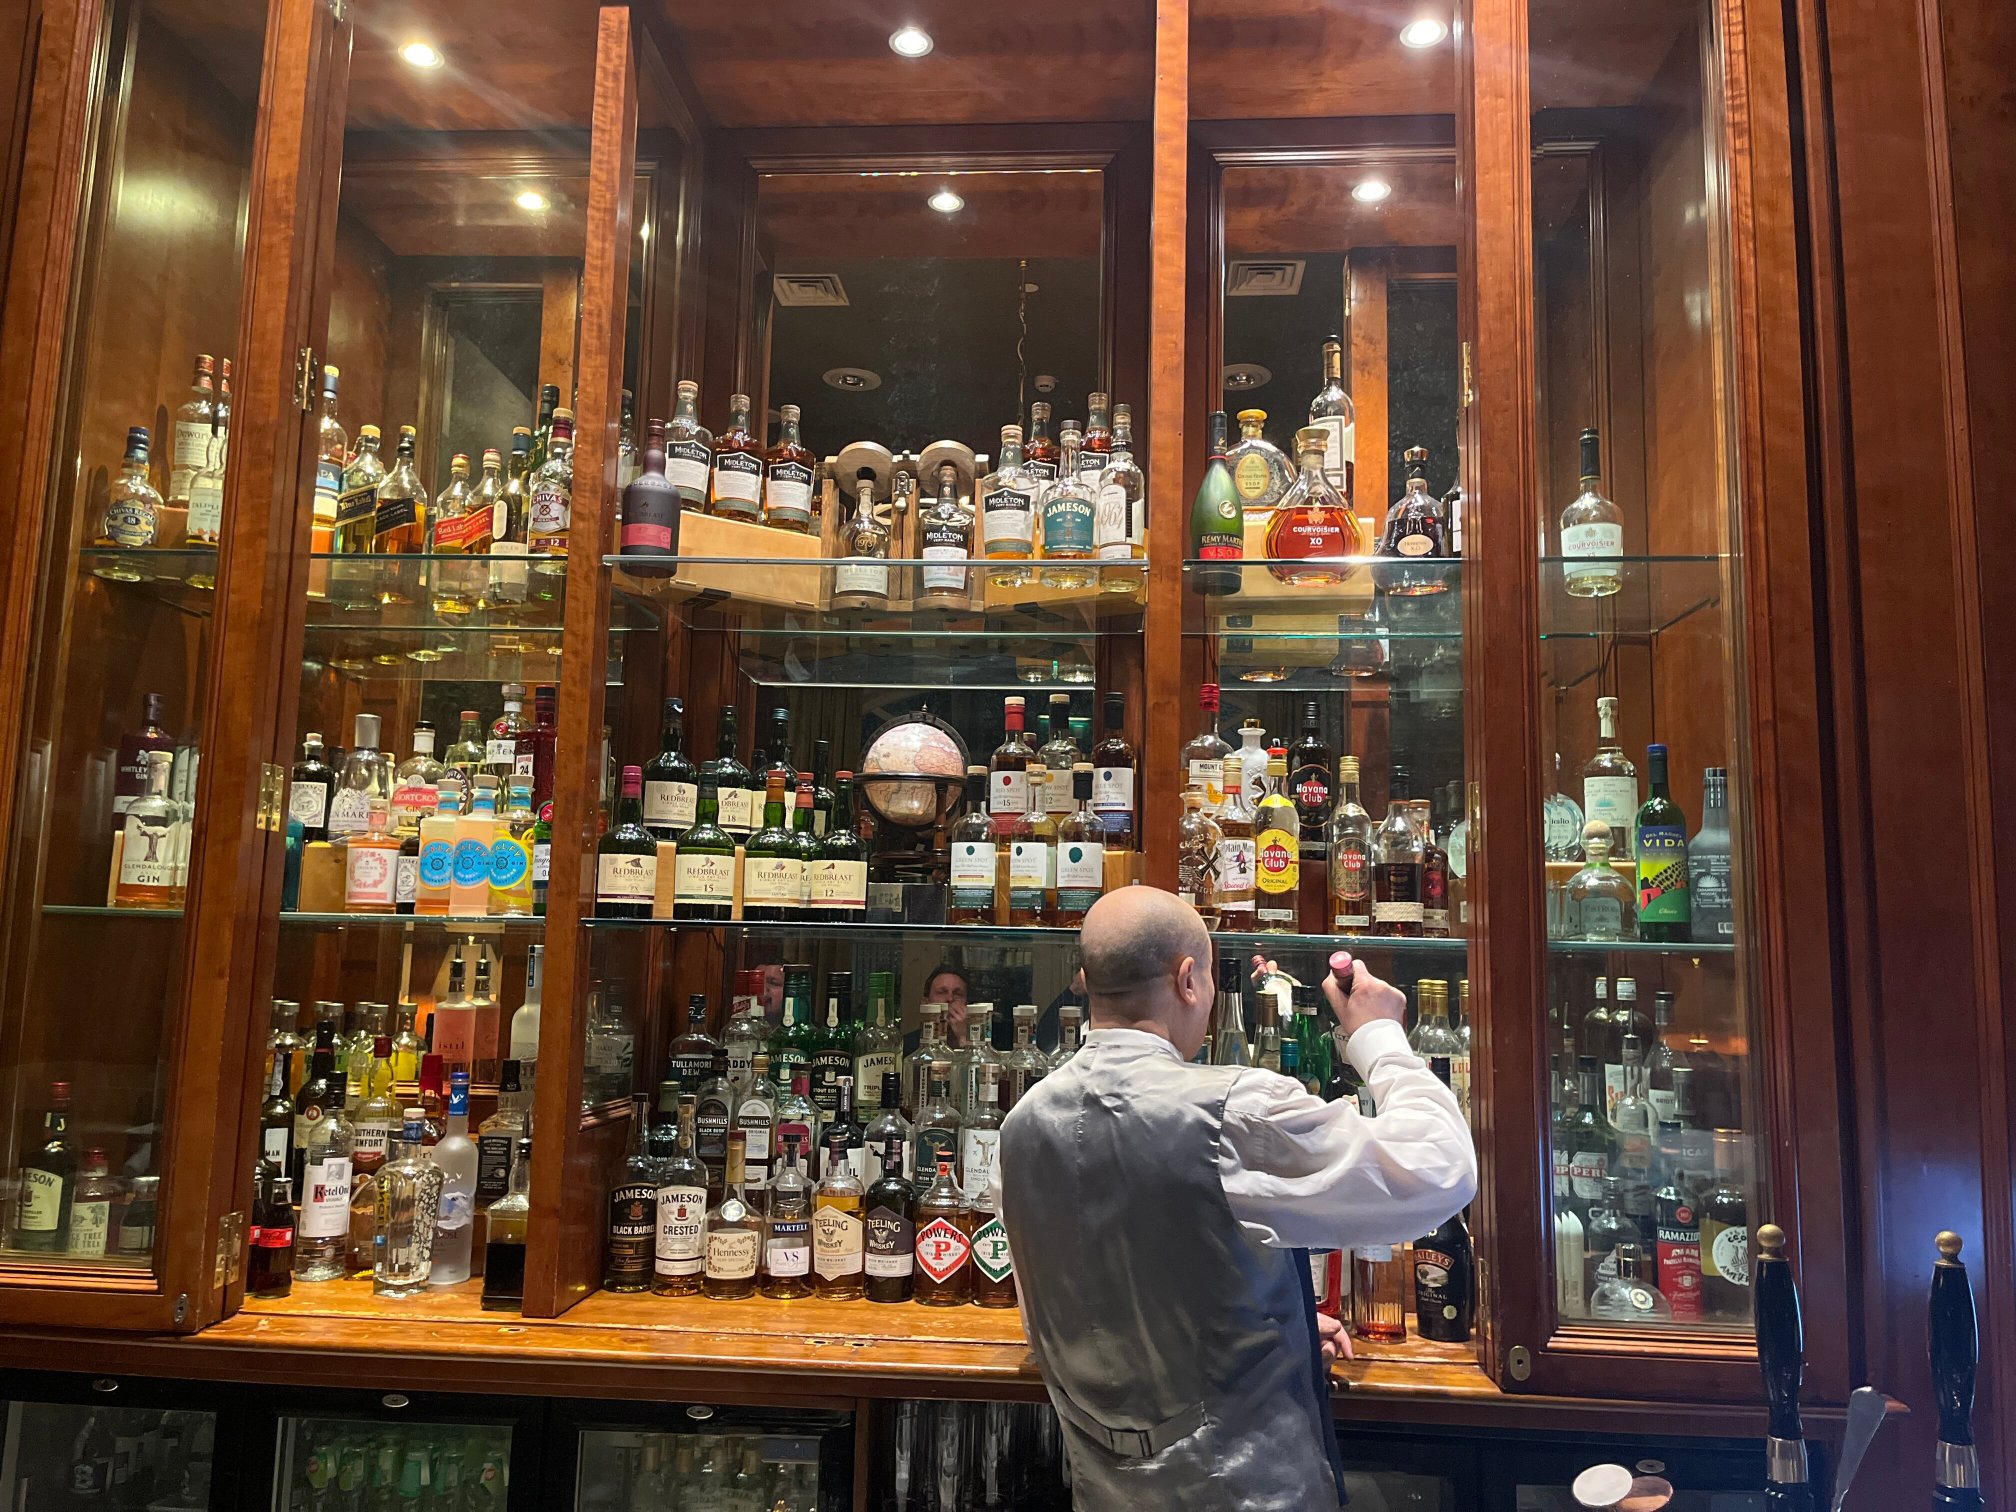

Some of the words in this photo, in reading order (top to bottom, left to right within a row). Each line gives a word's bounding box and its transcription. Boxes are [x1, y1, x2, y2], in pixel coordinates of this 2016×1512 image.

[674, 445, 709, 461] MIDLETON
[724, 458, 758, 471] MIDLETON
[775, 468, 809, 480] MIDLETON
[532, 494, 563, 505] CHIVAS
[988, 497, 1025, 508] MIDLETON
[110, 507, 133, 516] CHIVAS
[1046, 502, 1092, 518] JAMESON
[127, 516, 136, 524] 18
[1292, 526, 1340, 534] COURVOISIER
[926, 531, 964, 543] MIDLETON
[1201, 535, 1221, 545] RÉMY
[1309, 537, 1323, 547] XO
[550, 538, 561, 547] 12
[1568, 540, 1615, 551] COURVOISIER
[120, 765, 148, 774] WHITLEY
[519, 765, 530, 775] 24
[1296, 783, 1328, 795] Havana
[1002, 799, 1011, 807] 15
[1045, 796, 1053, 805] 12
[1105, 794, 1111, 802] 7
[1302, 793, 1322, 803] Club
[727, 814, 737, 822] 18
[1643, 839, 1685, 848] VIDA
[1259, 848, 1293, 859] Havana
[1337, 851, 1367, 862] Havana
[1264, 858, 1286, 868] Club
[1343, 859, 1361, 869] Club
[612, 867, 654, 876] REDBREAST
[686, 867, 730, 877] REDBREAST
[136, 875, 160, 883] GIN
[813, 873, 853, 881] REDBREAST
[703, 884, 715, 893] 15
[824, 889, 835, 898] 12
[812, 1056, 851, 1068] JAMESON
[864, 1056, 895, 1068] JAMES
[697, 1116, 729, 1125] BUSHMILLS
[739, 1118, 770, 1126] BUSHMILLS
[916, 1165, 937, 1173] GLENDA
[965, 1166, 990, 1174] GLENDAL
[1573, 1166, 1608, 1177] PERN
[313, 1185, 338, 1201] Ketel
[614, 1188, 657, 1203] JAMESON
[660, 1193, 704, 1205] JAMESON
[814, 1218, 849, 1231] TEELING
[867, 1218, 901, 1233] TEELING
[612, 1225, 633, 1236] BLACK
[633, 1224, 656, 1236] BARREL
[663, 1224, 699, 1236] CRESTED
[920, 1227, 964, 1243] POWERS
[976, 1227, 1007, 1240] POWE
[817, 1239, 843, 1249] WHISKEY
[869, 1239, 896, 1250] WHISKEY
[713, 1247, 750, 1257] Hennessy
[932, 1240, 952, 1261] P
[990, 1240, 1008, 1260] P
[783, 1251, 799, 1263] VS
